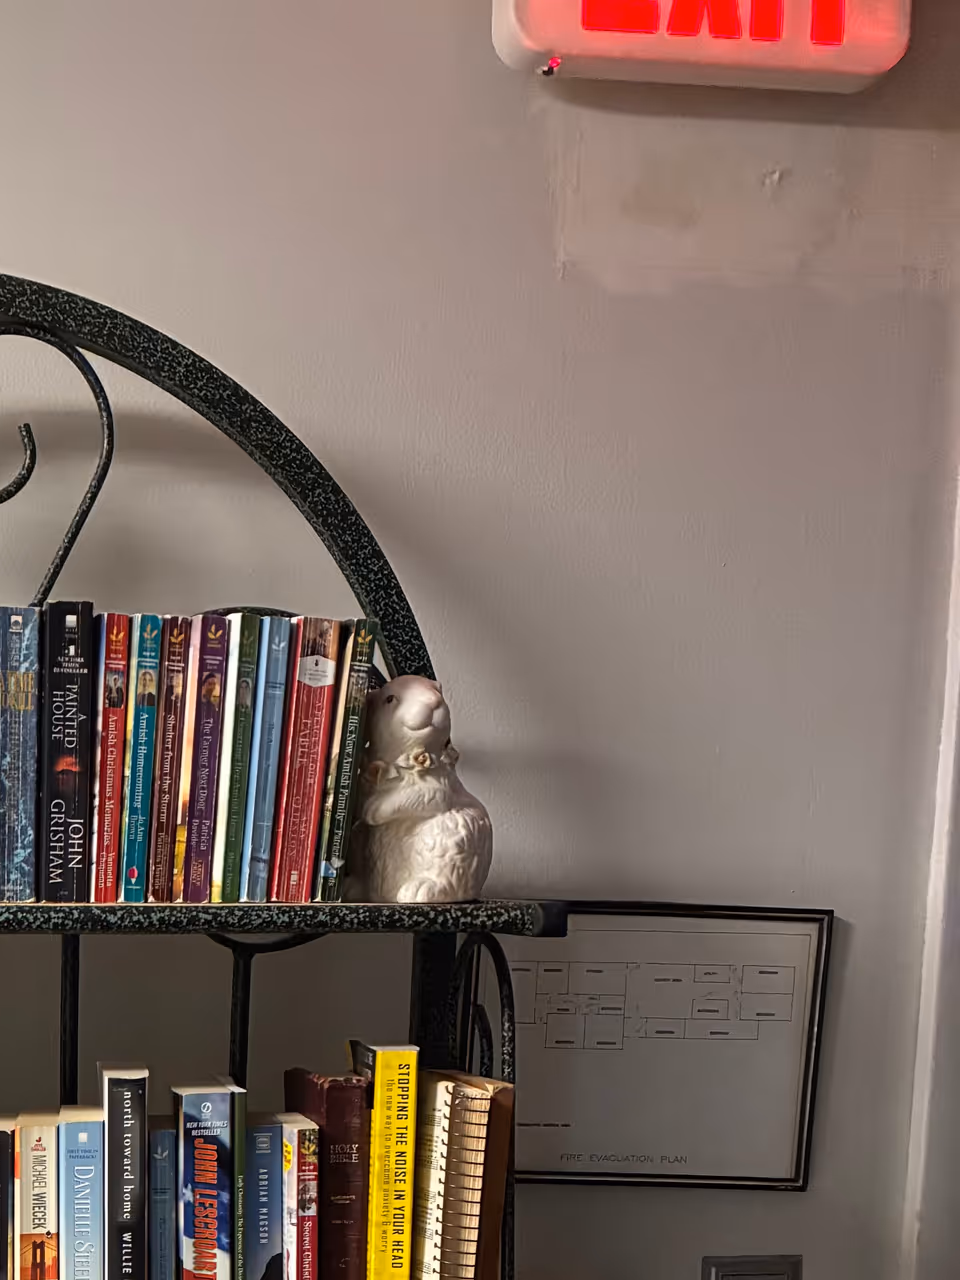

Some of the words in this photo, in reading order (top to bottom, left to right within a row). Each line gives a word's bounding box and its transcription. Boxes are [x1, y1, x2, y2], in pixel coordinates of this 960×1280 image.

[64, 684, 78, 748] PAINTED
[386, 1079, 395, 1091] the
[396, 1063, 410, 1120] STOPPING
[123, 1091, 132, 1131] north
[384, 1113, 393, 1129] way
[329, 1143, 358, 1153] HOLY
[384, 1133, 392, 1142] to
[395, 1125, 408, 1146] THE
[123, 1133, 135, 1182] toward
[192, 1138, 218, 1185] JOHN
[329, 1153, 359, 1163] BIBLE
[383, 1145, 392, 1185] overcome
[394, 1151, 407, 1184] NOISE
[560, 1153, 583, 1162] FIRE
[590, 1154, 655, 1164] EVACUATION
[660, 1155, 688, 1165] PLAN
[74, 1165, 95, 1237] DANIELLE
[123, 1186, 133, 1220] home
[380, 1188, 391, 1218] anxiety
[393, 1189, 406, 1202] IN
[392, 1206, 405, 1235] YOUR
[121, 1232, 133, 1275] WILLIE
[380, 1229, 389, 1253] worry
[391, 1239, 404, 1269] HEAD
